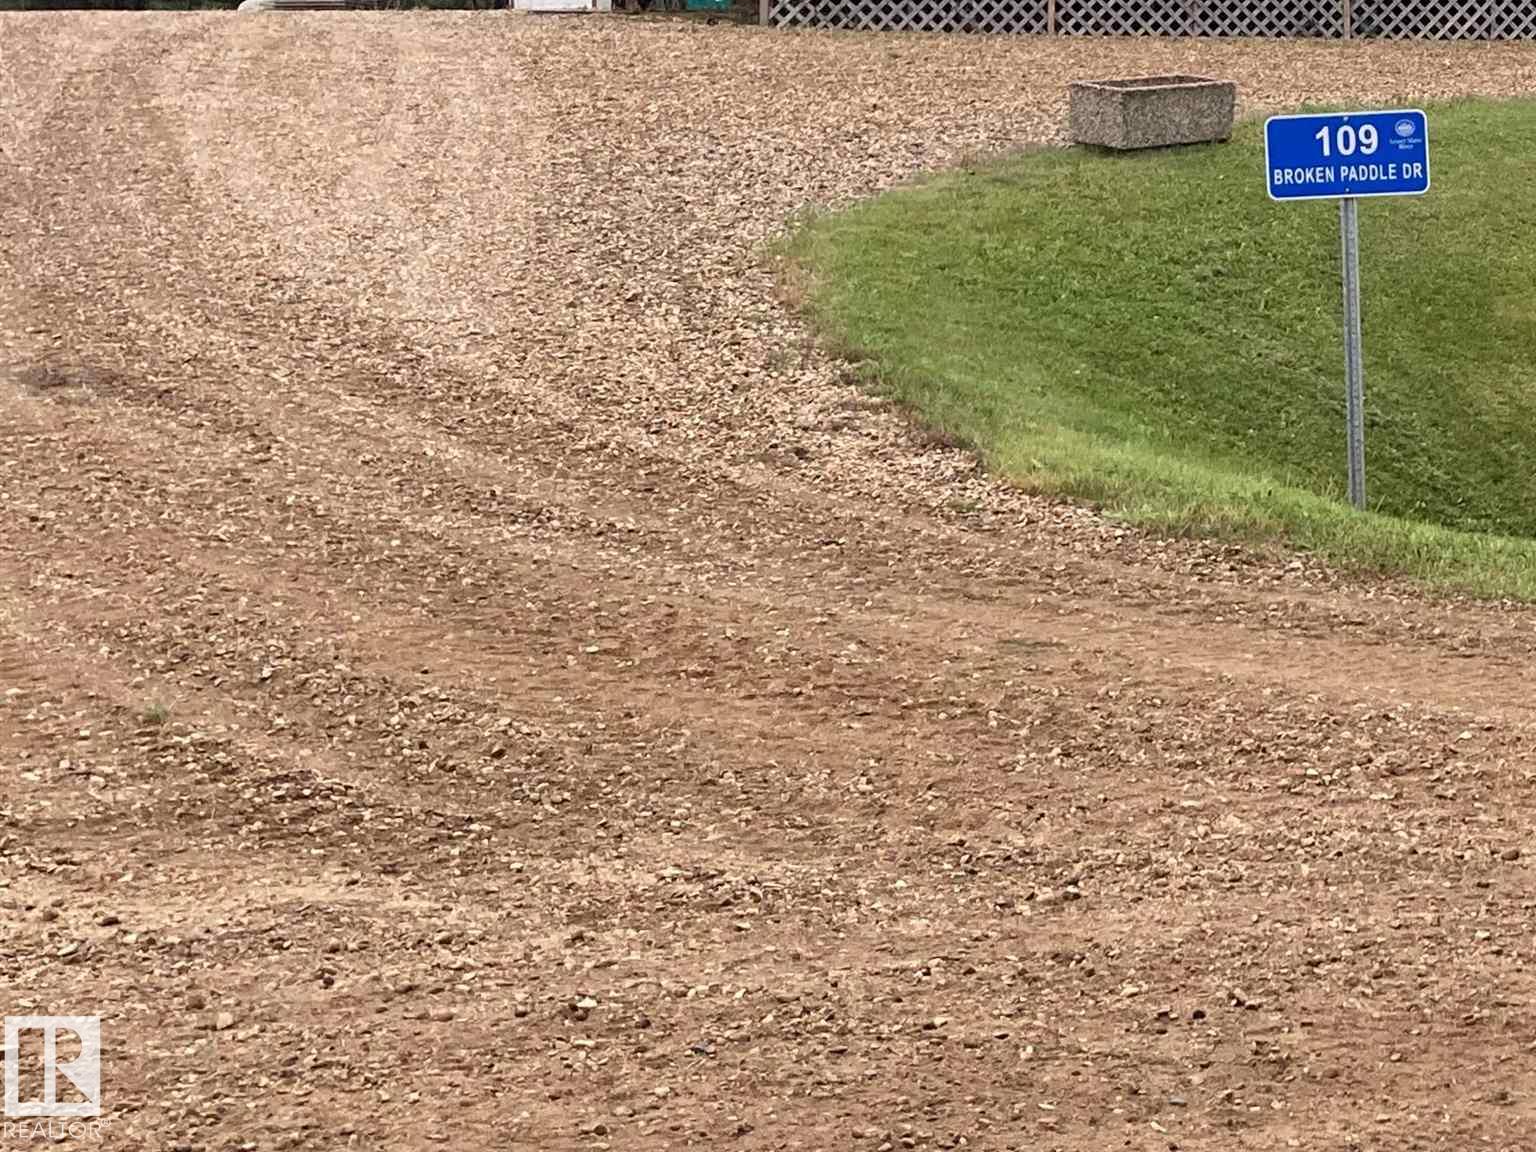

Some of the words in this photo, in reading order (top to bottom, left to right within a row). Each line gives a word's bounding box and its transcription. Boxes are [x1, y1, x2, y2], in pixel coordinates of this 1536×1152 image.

[1315, 124, 1379, 157] 109
[1274, 166, 1335, 185] BROKEN
[1340, 163, 1397, 182] PADDLE
[1402, 162, 1423, 179] DR
